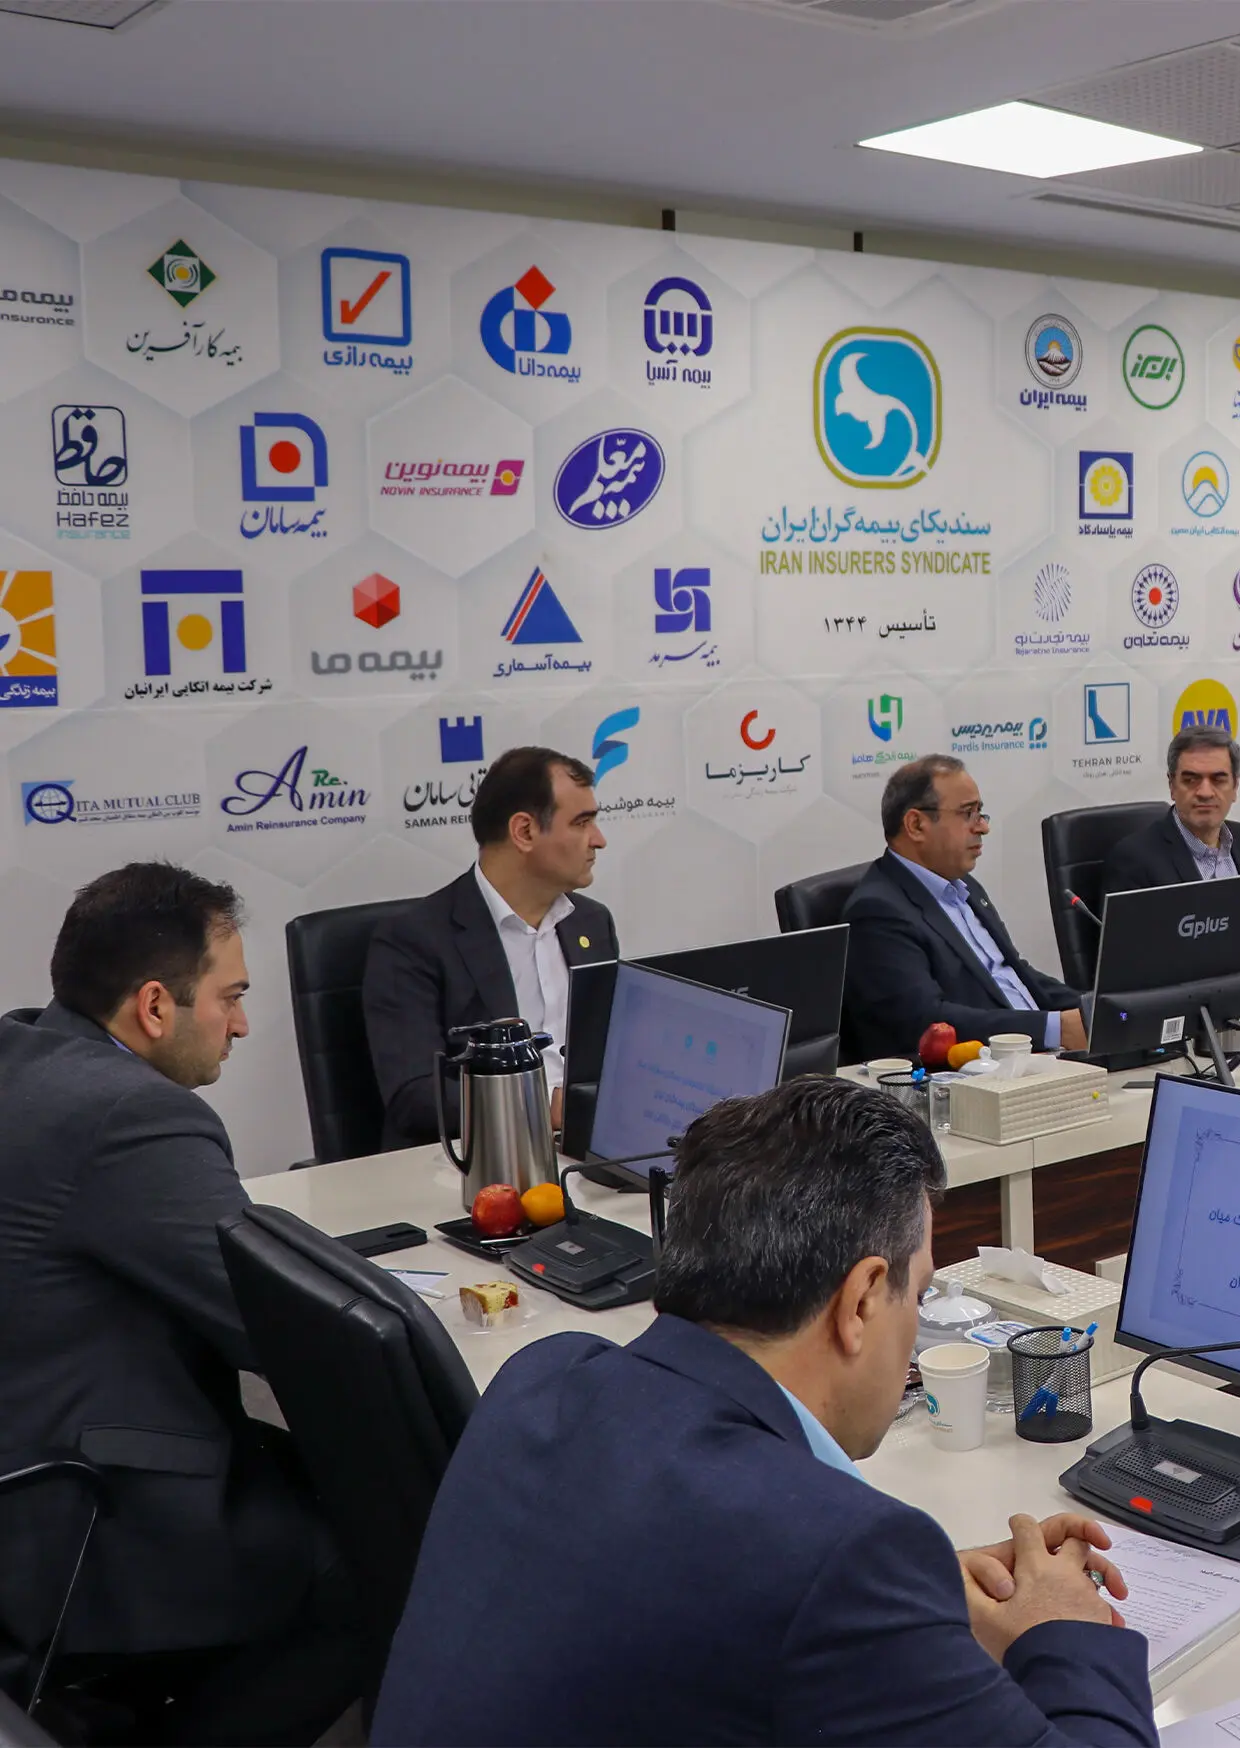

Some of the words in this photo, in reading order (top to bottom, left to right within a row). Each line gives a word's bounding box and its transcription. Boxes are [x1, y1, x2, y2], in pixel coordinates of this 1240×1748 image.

[21, 291, 73, 313] بیمه
[0, 313, 75, 326] nsurance
[219, 345, 242, 366] بیمه
[324, 346, 366, 368] رازی
[370, 353, 413, 376] بیمه
[518, 357, 547, 378] دانا
[546, 362, 581, 383] بیمه
[646, 359, 678, 386] آسیا
[682, 368, 711, 389] بیمه
[1020, 388, 1054, 410] ایران
[1056, 392, 1087, 412] بیمه
[385, 458, 442, 482] نوین
[442, 463, 490, 484] بیمه
[97, 492, 128, 511] بیمه
[380, 486, 416, 497] NOVIN
[419, 487, 484, 497] INSURANCE
[57, 511, 130, 528] Hafez
[240, 505, 300, 539] سامان
[292, 508, 328, 538] بیمه
[762, 505, 817, 543] ایران
[900, 509, 991, 544] سندیکای
[1117, 526, 1133, 539] بیمه
[760, 550, 803, 575] IRAN
[808, 551, 896, 575] INSURERS
[901, 552, 991, 575] SYNDICATE
[824, 614, 868, 633] ۱۳۴۴
[878, 608, 936, 640] تأسیس
[1066, 632, 1090, 646] بیمه
[1123, 631, 1160, 650] تعاون
[1160, 634, 1191, 650] بیمه
[311, 650, 352, 676] ما
[359, 650, 443, 680] بیمه
[492, 653, 555, 678] آسماری
[553, 658, 592, 673] بیمه
[700, 645, 721, 667] بیمه
[32, 686, 56, 699] بیمه
[124, 681, 169, 700] ایرانیان
[172, 680, 210, 698] اتکایی
[213, 681, 235, 696] بیمه
[238, 678, 273, 695] شرکت
[952, 722, 994, 739] پردیس
[994, 721, 1024, 737] بیمه
[951, 741, 979, 752] Pardis
[982, 740, 1024, 751] Insurance
[705, 754, 811, 785] کاریزما
[1072, 757, 1112, 767] TEHRAN
[1115, 755, 1142, 765] RUCK
[104, 796, 161, 810] MUTUAL
[165, 793, 200, 806] CLUB
[403, 781, 458, 812] سامان
[647, 797, 675, 809] بیمه
[227, 823, 253, 833] Amin
[256, 817, 318, 831] Reinsurance
[320, 814, 367, 826] Company
[404, 816, 447, 829] SAMAN
[1178, 913, 1230, 940] Gplus
[1208, 1207, 1231, 1225] میان
